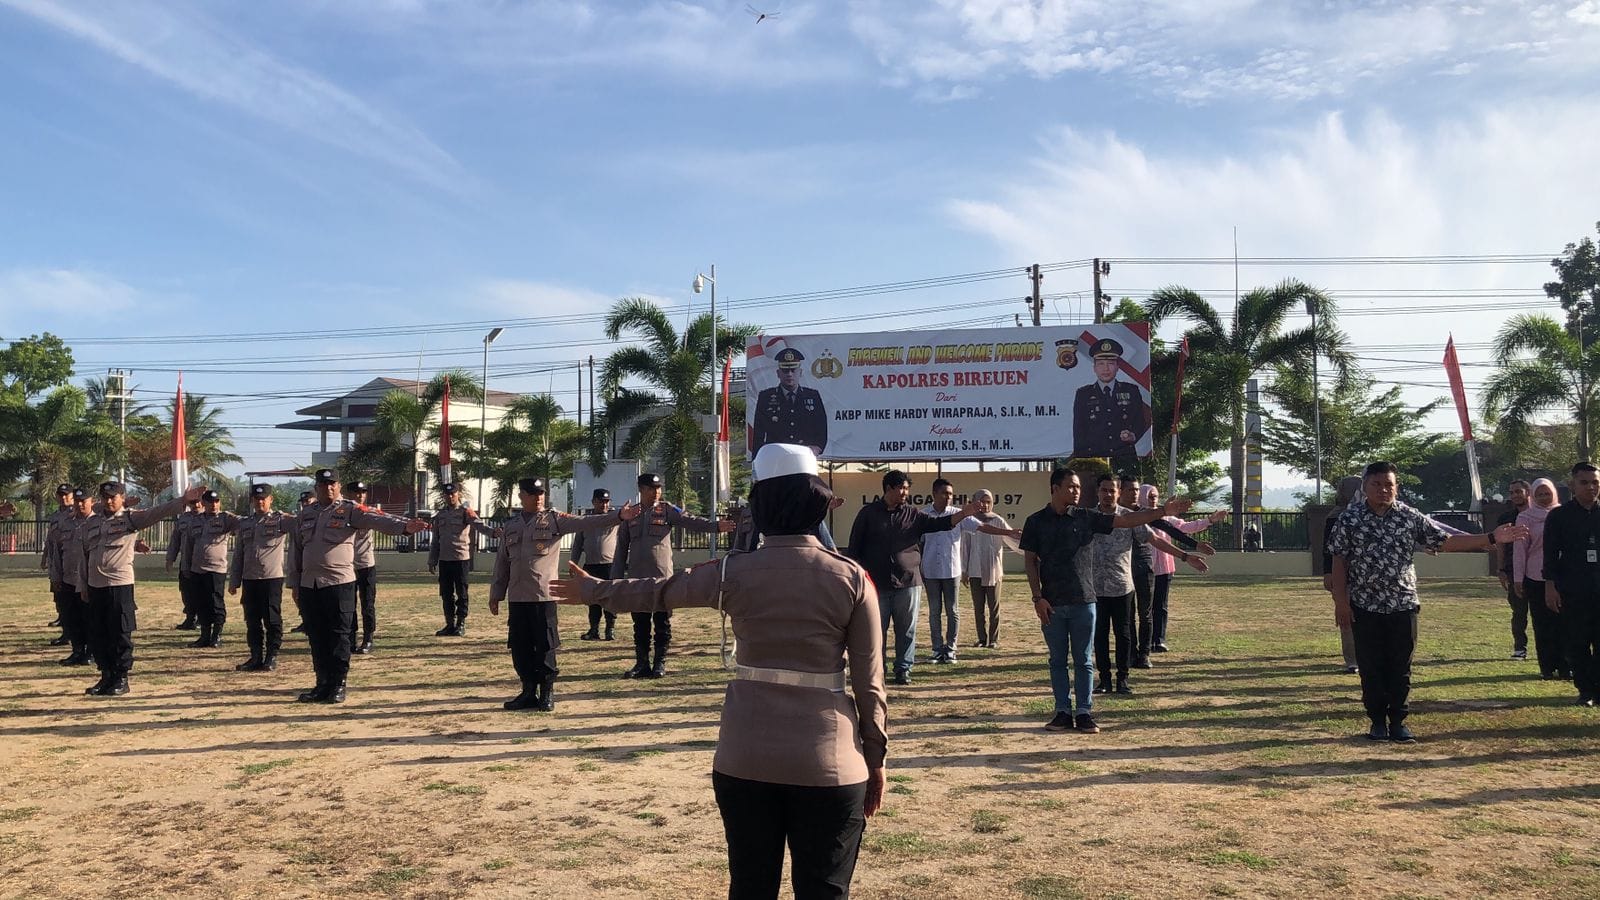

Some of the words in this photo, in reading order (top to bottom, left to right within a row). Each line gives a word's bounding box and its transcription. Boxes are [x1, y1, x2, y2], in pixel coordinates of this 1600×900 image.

[847, 346, 904, 366] FAREWELL
[906, 345, 932, 365] AND
[935, 343, 993, 364] WELCOME
[994, 341, 1044, 362] PARADE
[863, 373, 949, 388] KAPOLRES
[953, 370, 1029, 386] BIREUEN
[936, 391, 957, 401] Dari
[835, 410, 861, 420] AKBP
[865, 409, 890, 419] MIKE
[894, 408, 928, 418] HARDY
[932, 406, 997, 418] WIRAPRAJA,
[1001, 406, 1031, 417] S.I.K.,
[1035, 405, 1059, 416] M.H.
[929, 424, 962, 437] Kepada
[879, 441, 906, 451] AKBP
[909, 440, 958, 452] JATMIKO,
[962, 440, 985, 451] S.H.,
[989, 439, 1013, 450] M.H.
[1004, 494, 1023, 505] 97
